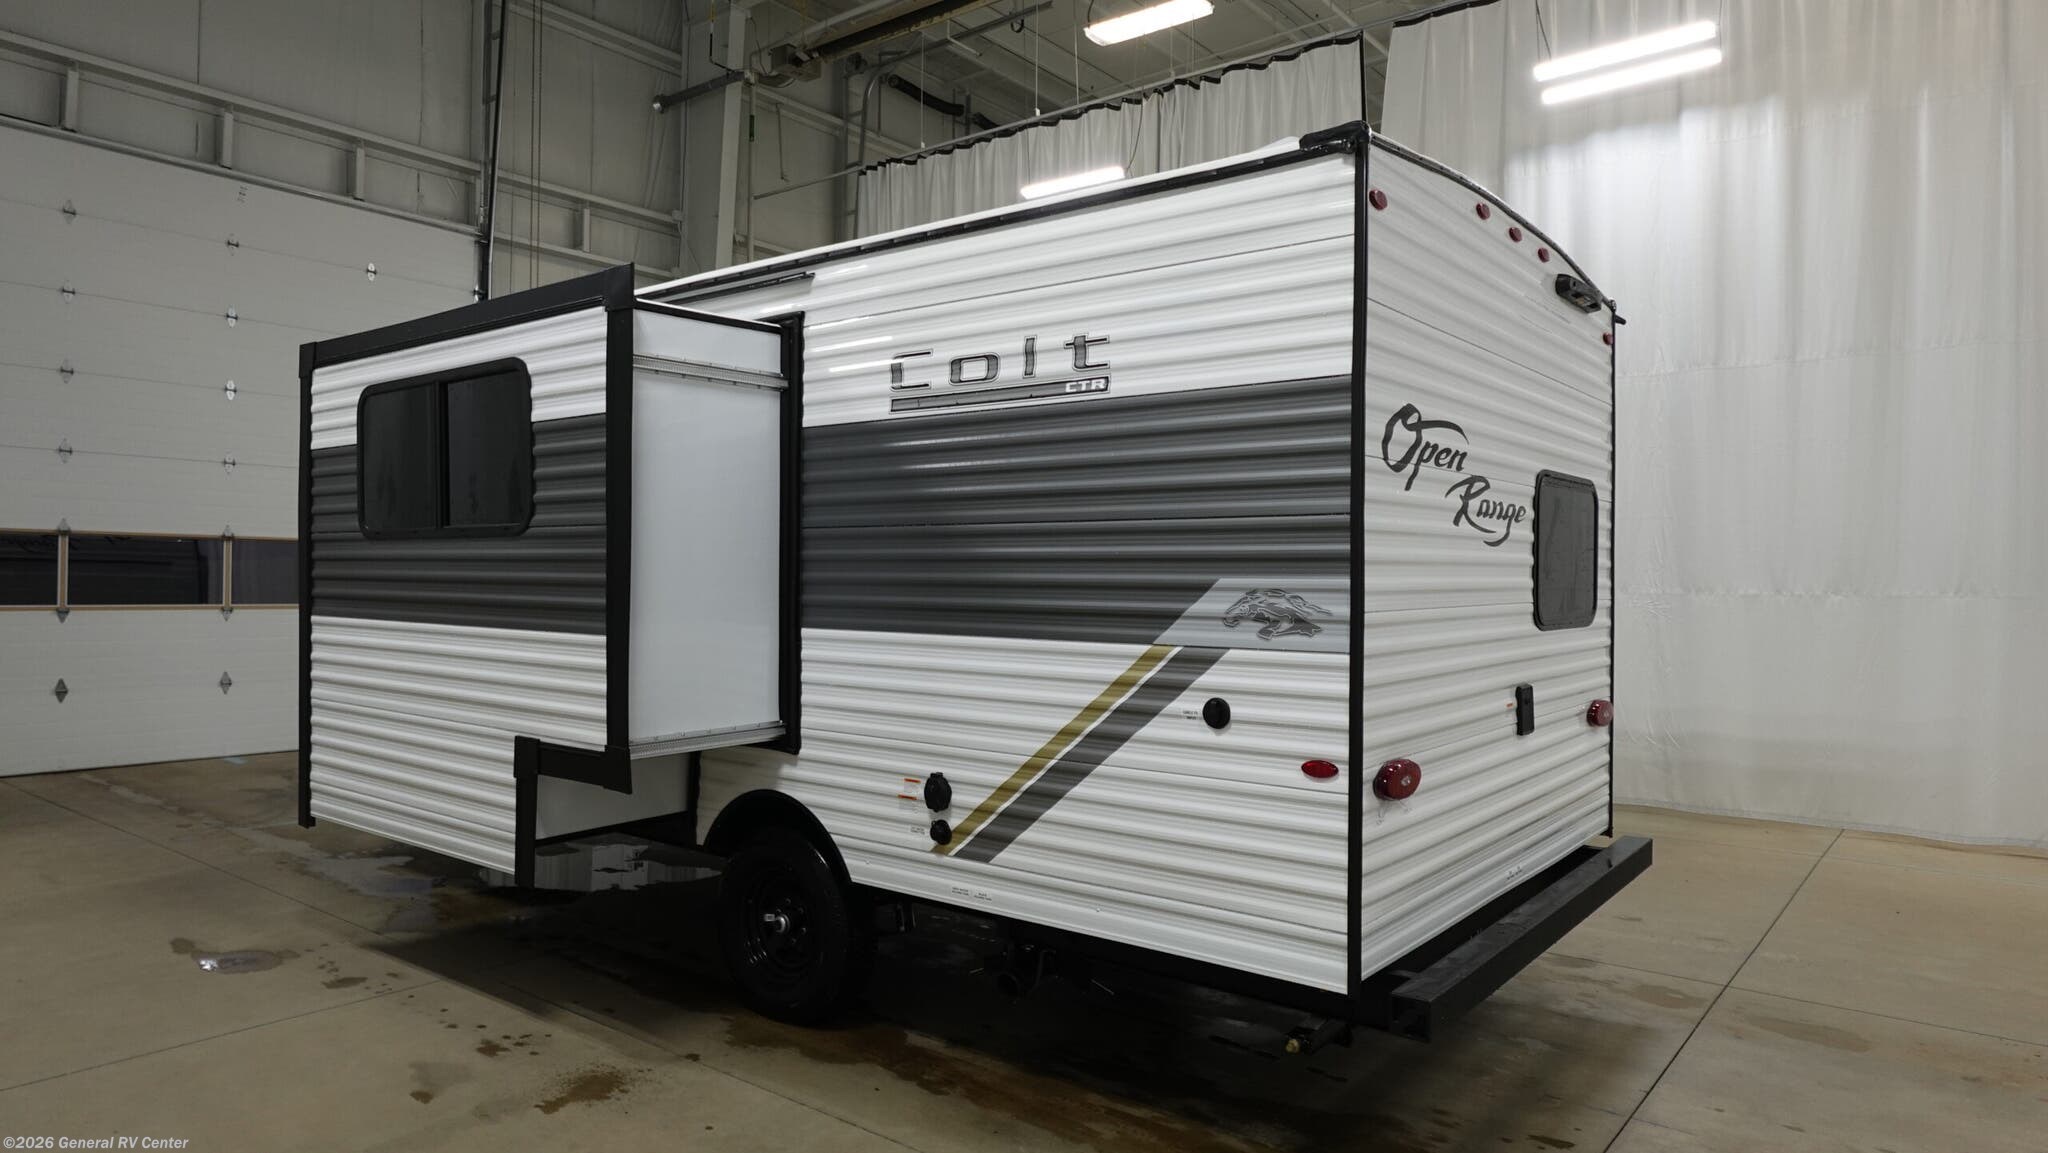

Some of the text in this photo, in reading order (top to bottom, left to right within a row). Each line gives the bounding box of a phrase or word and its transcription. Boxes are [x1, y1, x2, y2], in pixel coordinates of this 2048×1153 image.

[890, 333, 1110, 392] Colt
[1065, 379, 1106, 393] CTR
[1382, 403, 1469, 491] Open
[1445, 475, 1526, 546] Range
